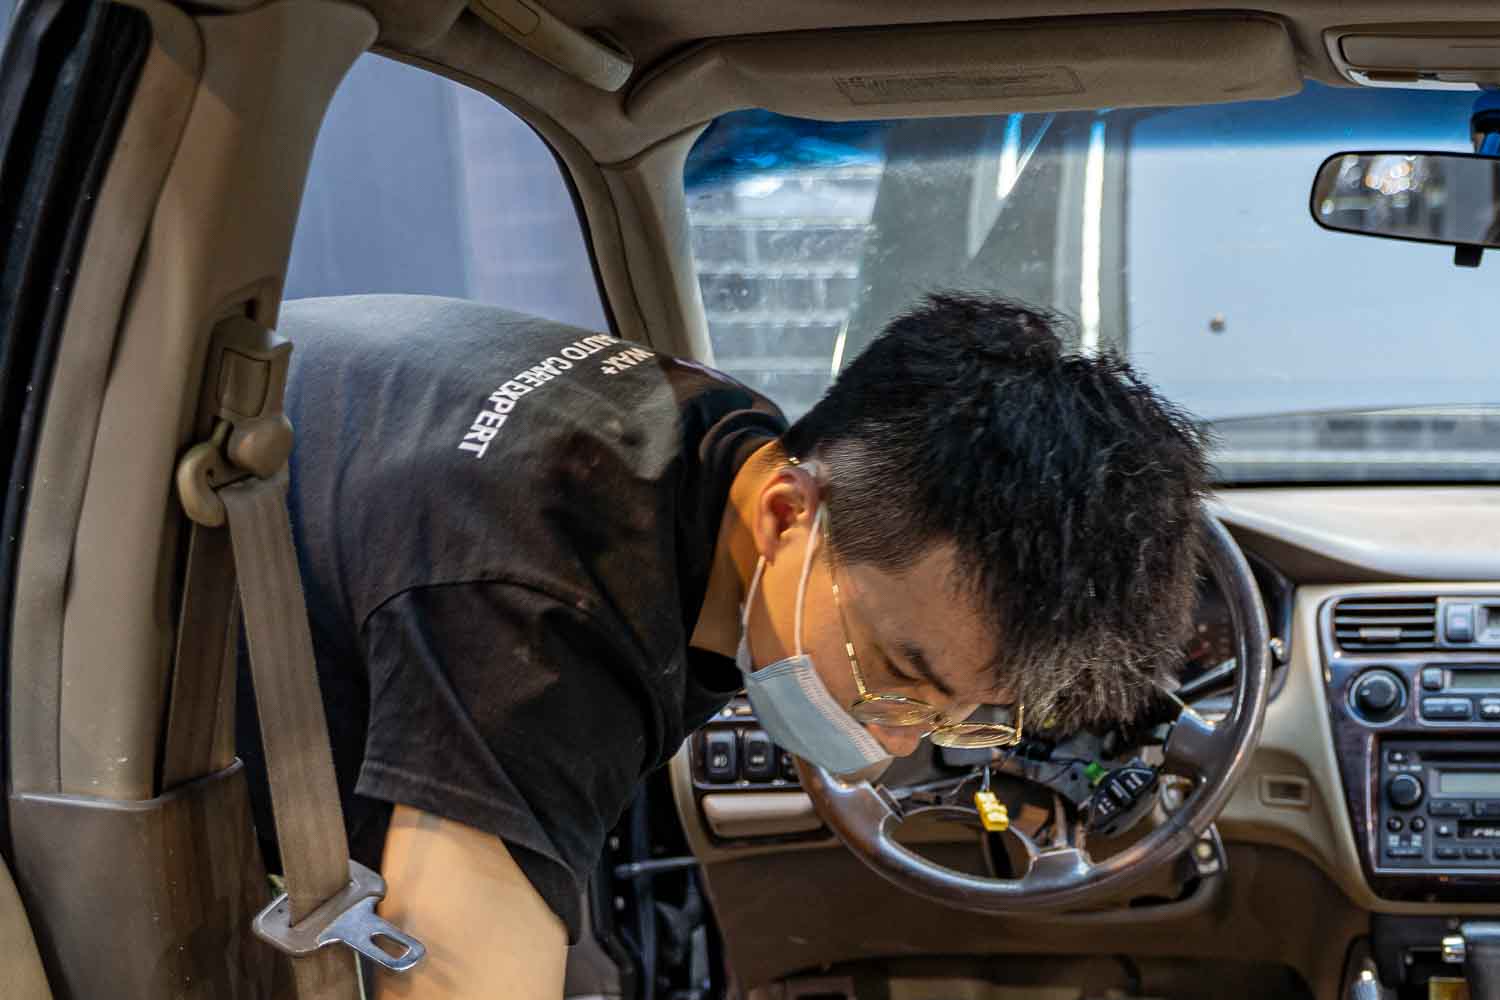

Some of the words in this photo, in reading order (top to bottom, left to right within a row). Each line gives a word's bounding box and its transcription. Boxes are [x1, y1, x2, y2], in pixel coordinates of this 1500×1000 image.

[560, 334, 619, 360] AUTO
[513, 357, 573, 388] CARE
[457, 380, 534, 459] EXPERT
